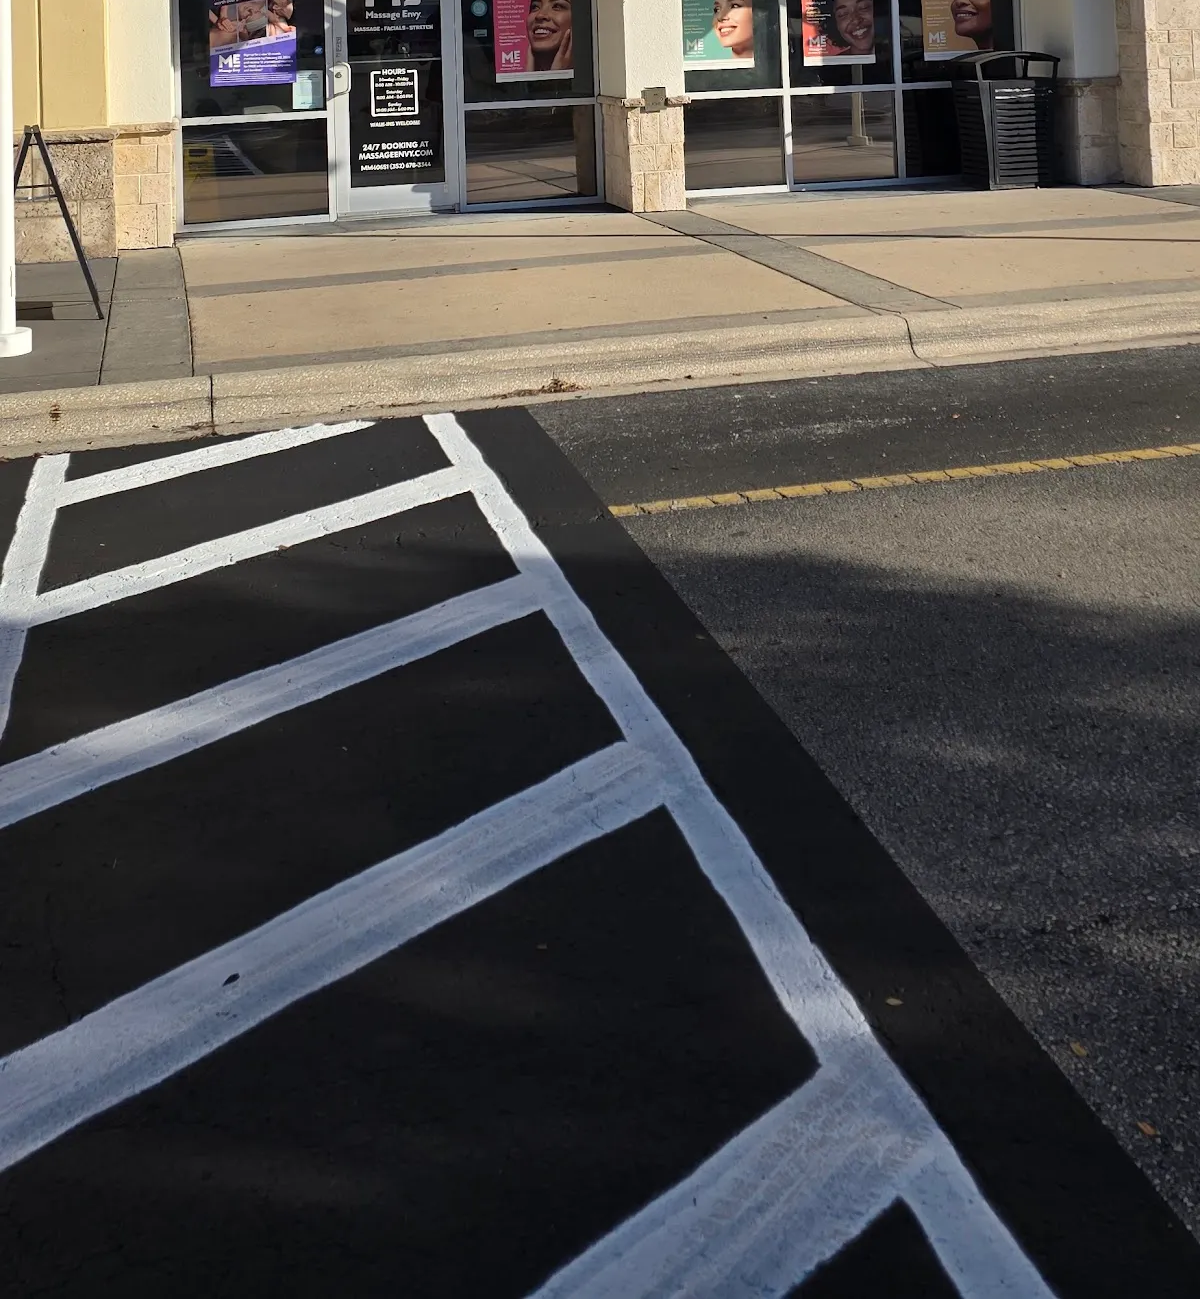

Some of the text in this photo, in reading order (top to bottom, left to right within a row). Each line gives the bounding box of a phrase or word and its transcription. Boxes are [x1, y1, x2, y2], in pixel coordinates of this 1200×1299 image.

[365, 10, 422, 20] Massage Envy
[808, 35, 827, 48] ME
[928, 31, 946, 44] ME
[686, 38, 704, 51] ME
[218, 54, 240, 68] ME
[501, 50, 520, 63] ME
[395, 119, 420, 127] WELCOME
[362, 143, 380, 151] 24/7
[381, 141, 418, 150] BOOKING
[358, 149, 433, 161] MASSAGEENVY.COM
